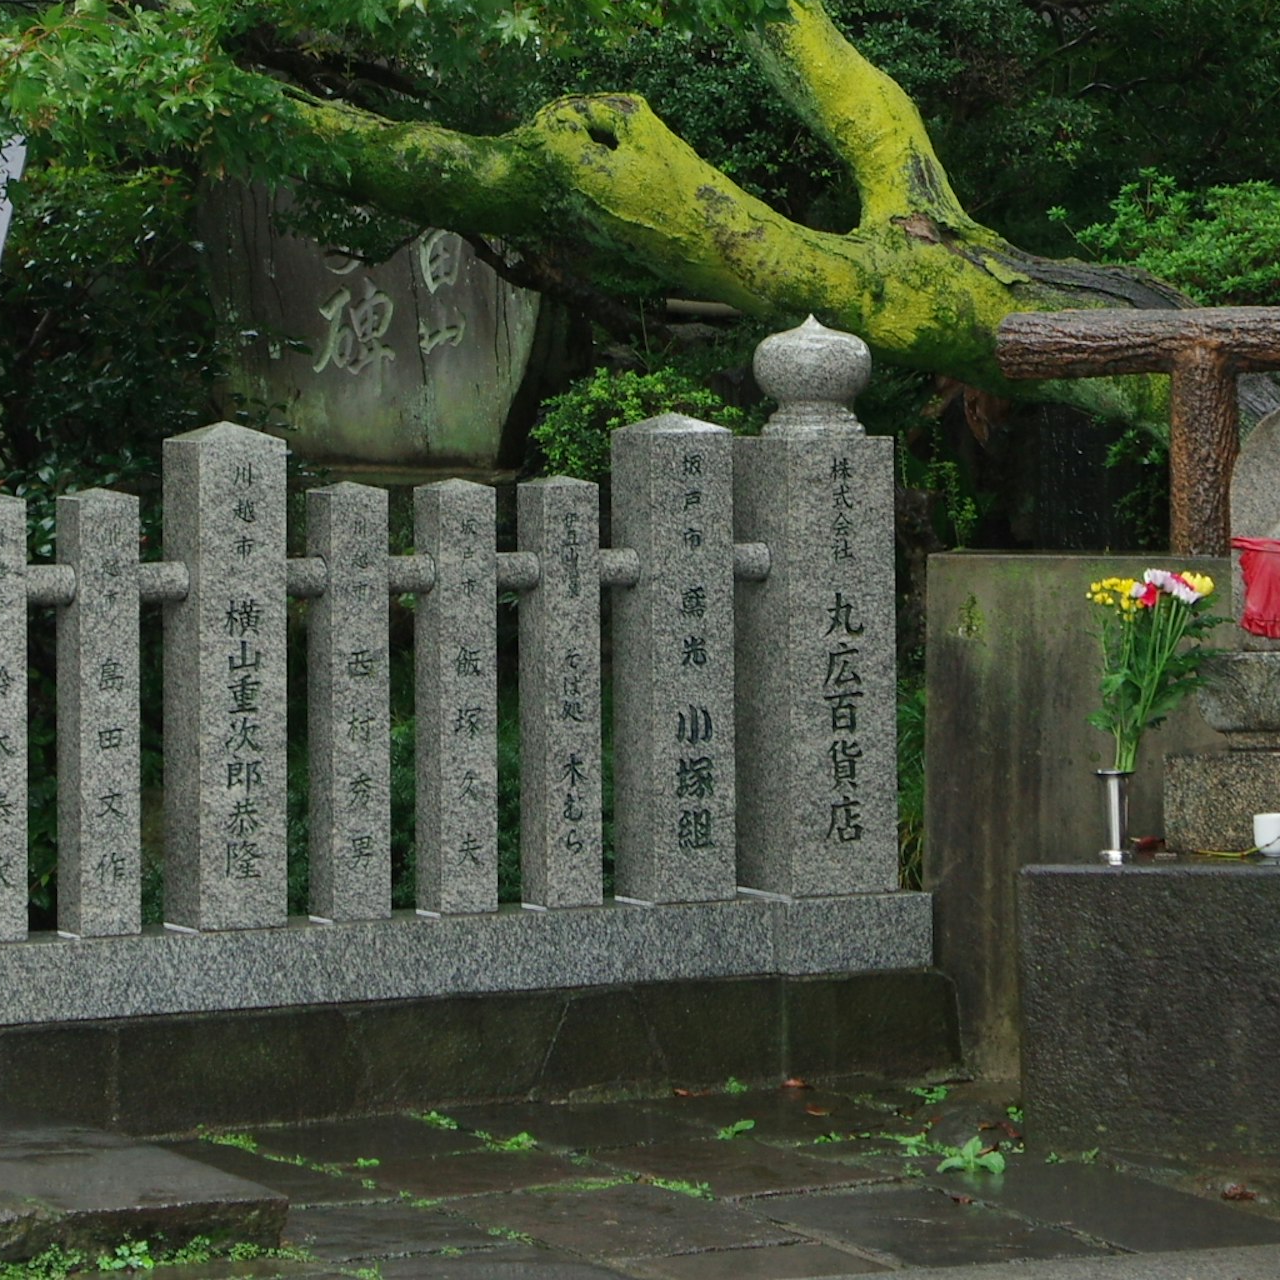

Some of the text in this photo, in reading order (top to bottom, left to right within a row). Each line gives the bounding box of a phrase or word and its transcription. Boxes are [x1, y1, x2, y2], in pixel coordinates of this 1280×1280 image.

[232, 462, 255, 562] 川越市
[681, 453, 704, 551] 坂戸市
[822, 458, 865, 846] 株式会社 丸広百貨店
[346, 649, 375, 871] 西村秀男
